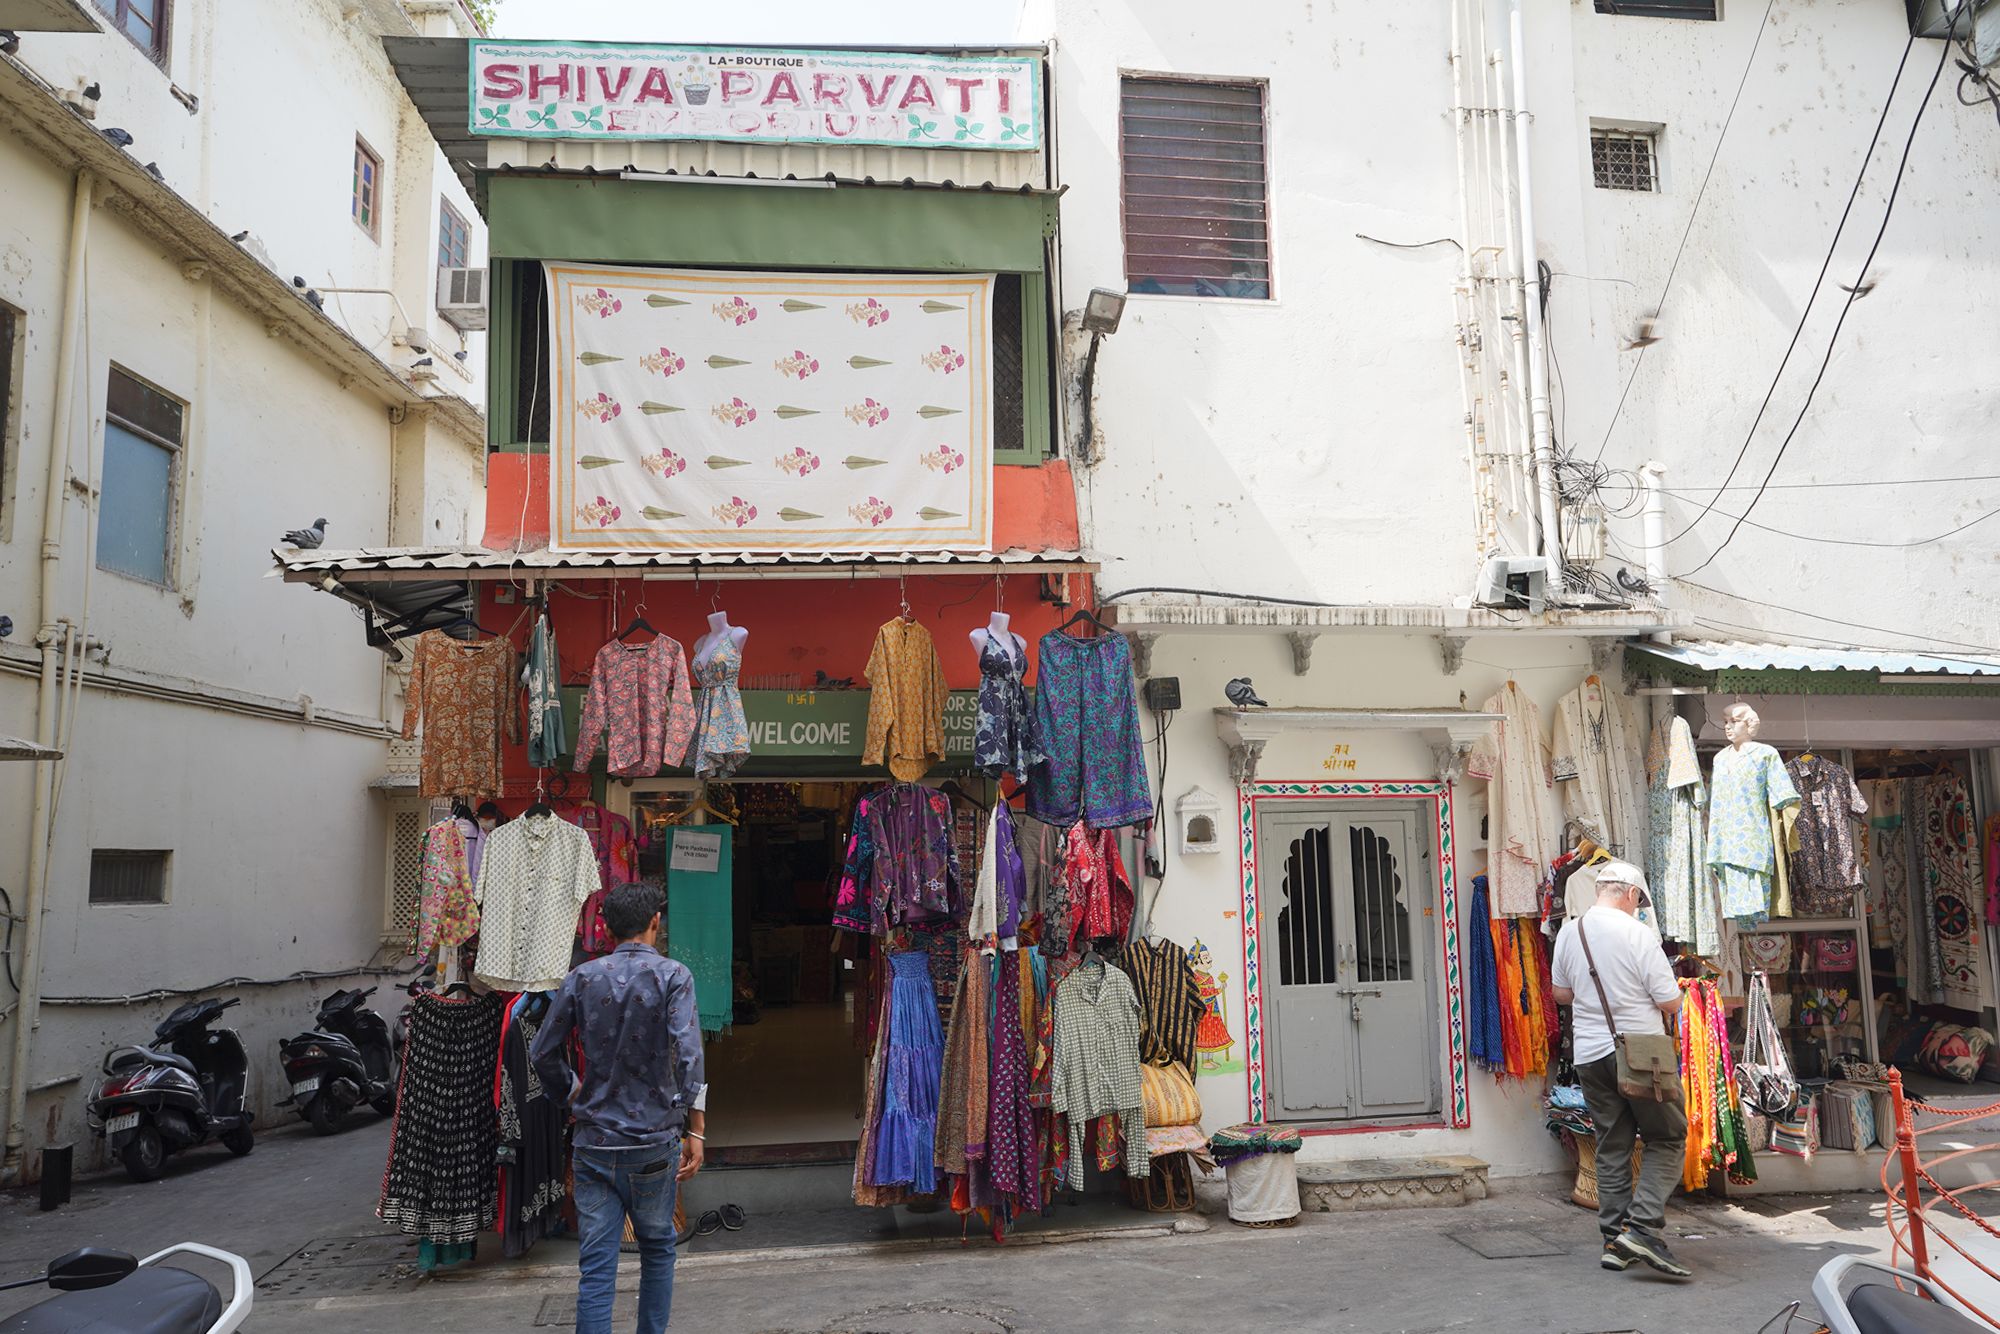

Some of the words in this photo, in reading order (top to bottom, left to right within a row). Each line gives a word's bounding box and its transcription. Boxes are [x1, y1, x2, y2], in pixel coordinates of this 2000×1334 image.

[708, 56, 804, 67] LA-BOUTIQUE
[482, 63, 674, 105] SHIVA
[720, 70, 1011, 113] PARVATI
[748, 721, 850, 745] WELCOME
